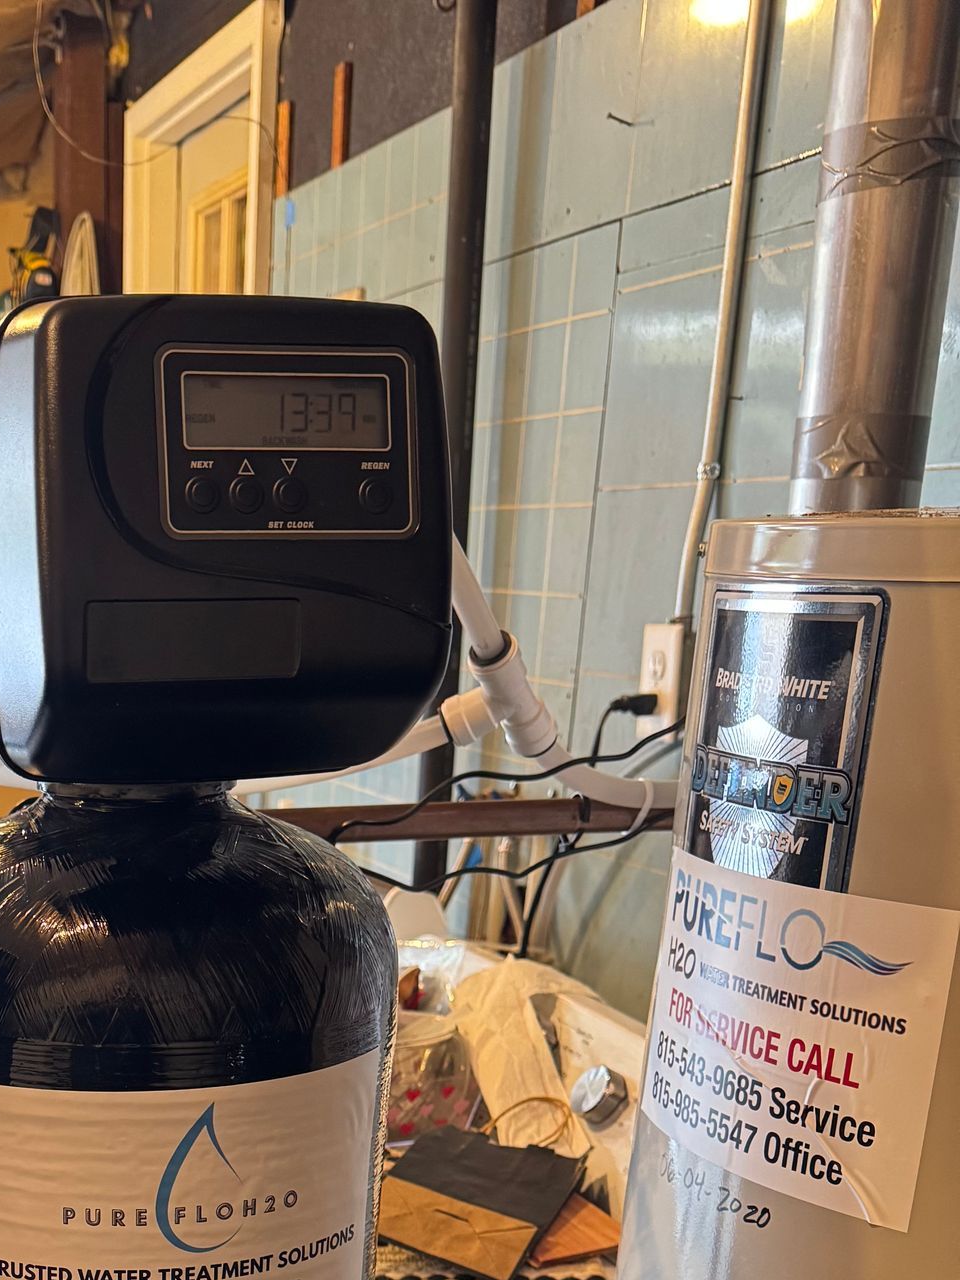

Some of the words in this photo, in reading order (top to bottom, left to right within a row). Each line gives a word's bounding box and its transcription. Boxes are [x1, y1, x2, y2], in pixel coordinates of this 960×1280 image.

[281, 392, 356, 432] 13:39
[190, 460, 214, 469] NEXT
[360, 462, 390, 470] REGEN
[268, 521, 283, 529] SET
[287, 521, 314, 529] CLOCK
[692, 744, 852, 825] DEFENDER
[741, 824, 806, 855] SYSTEM
[671, 869, 826, 971] PUREFLO
[668, 936, 696, 980] H2O
[700, 962, 729, 989] WATER
[732, 975, 807, 1011] TREATMENT
[810, 999, 907, 1035] SOLUTIONS
[669, 987, 693, 1025] FOR
[696, 1002, 781, 1065] SERVICE
[788, 1038, 860, 1089] CALL
[657, 1030, 763, 1111] 815-543-9685
[769, 1087, 876, 1148] Service
[653, 1071, 758, 1154] 815-985-5547
[764, 1132, 843, 1185] Office
[62, 1206, 148, 1227] PURE
[174, 1189, 298, 1225] FLOH2O
[277, 1223, 354, 1268] SOLUTIONS
